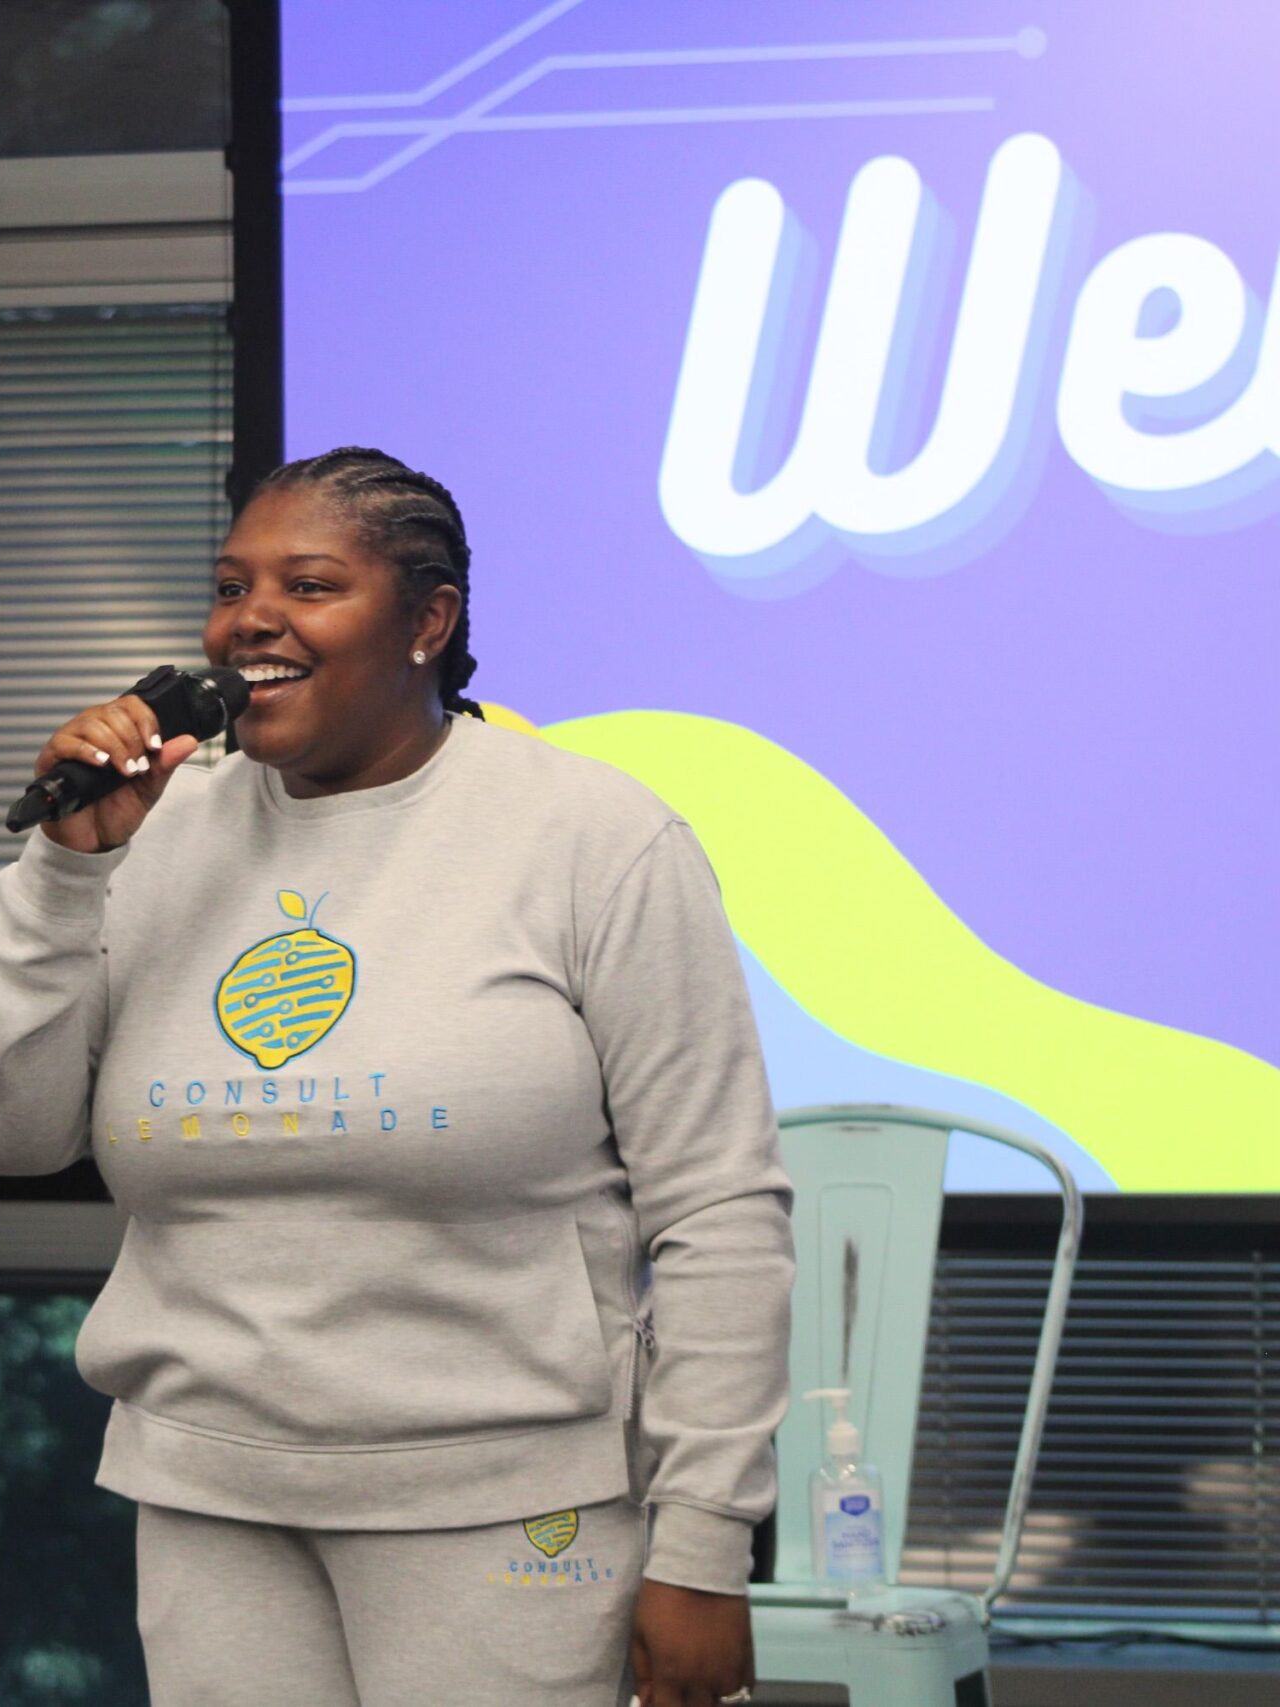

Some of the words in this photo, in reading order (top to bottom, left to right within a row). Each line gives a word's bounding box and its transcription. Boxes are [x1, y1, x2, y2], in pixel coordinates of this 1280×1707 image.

[148, 1072, 385, 1107] CONSULT
[106, 1107, 449, 1144] LEMONADE
[509, 1558, 594, 1573] CONSULT
